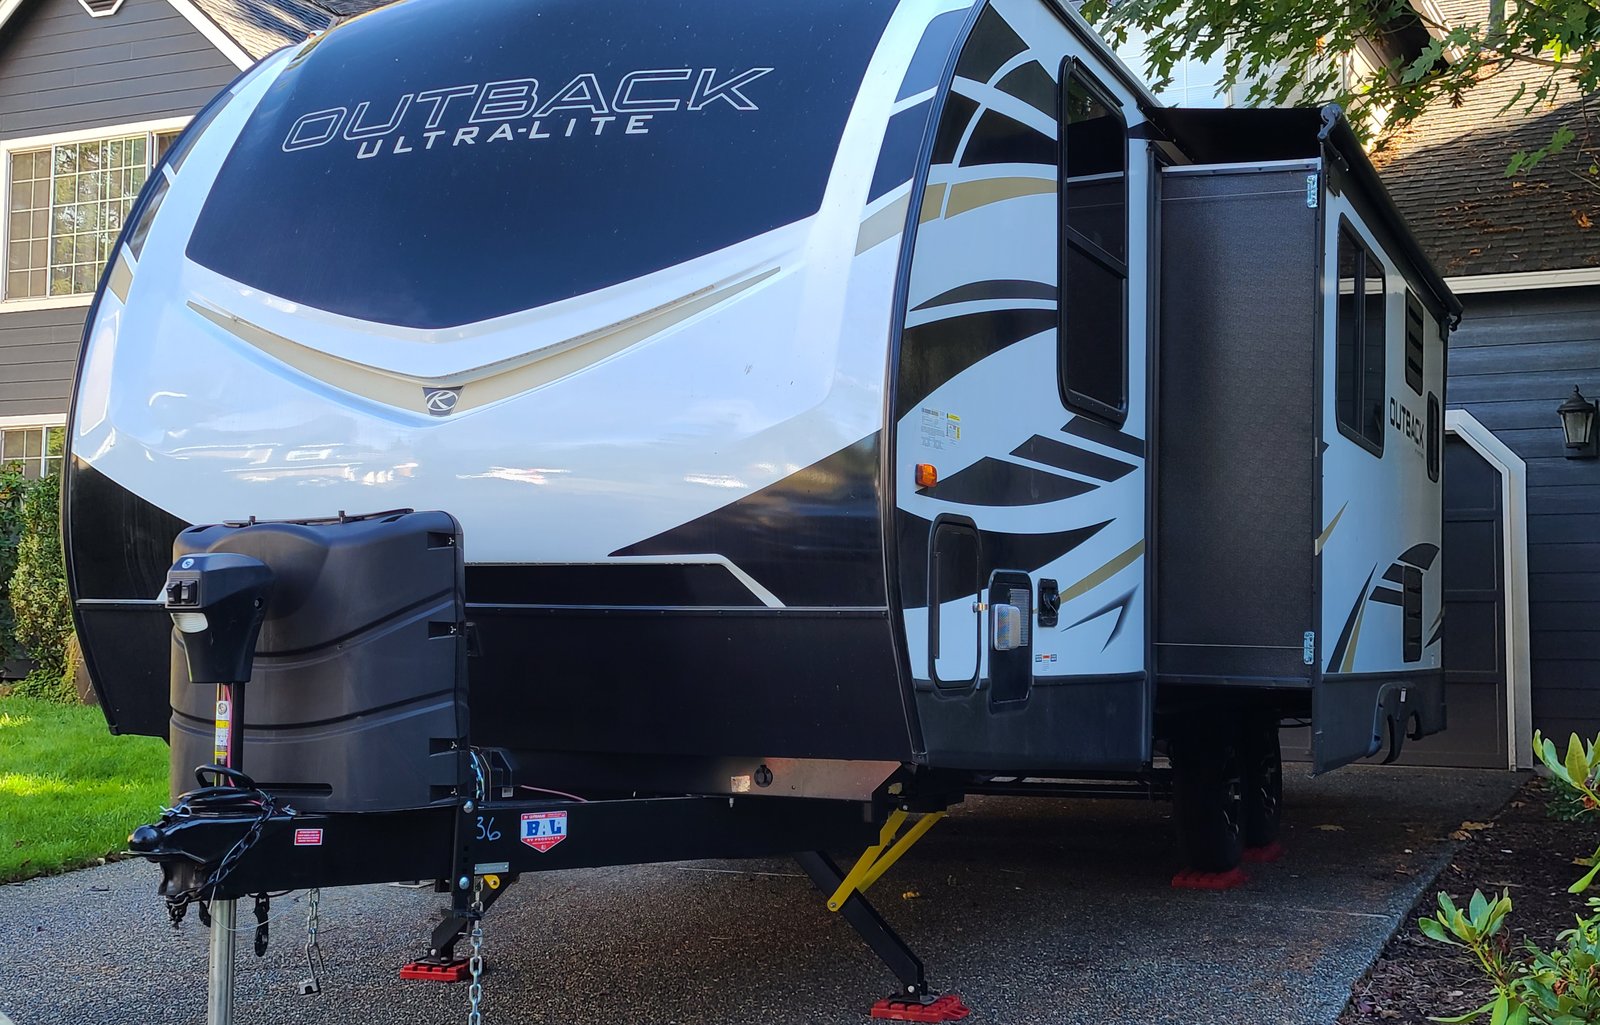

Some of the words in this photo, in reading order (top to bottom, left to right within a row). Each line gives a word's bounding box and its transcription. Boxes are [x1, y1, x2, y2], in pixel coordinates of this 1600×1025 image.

[282, 67, 775, 153] OUTBACK
[356, 114, 654, 160] ULTRA-LITE
[1390, 396, 1425, 449] OUTBACK
[476, 816, 501, 841] 36
[526, 819, 562, 836] BAL
